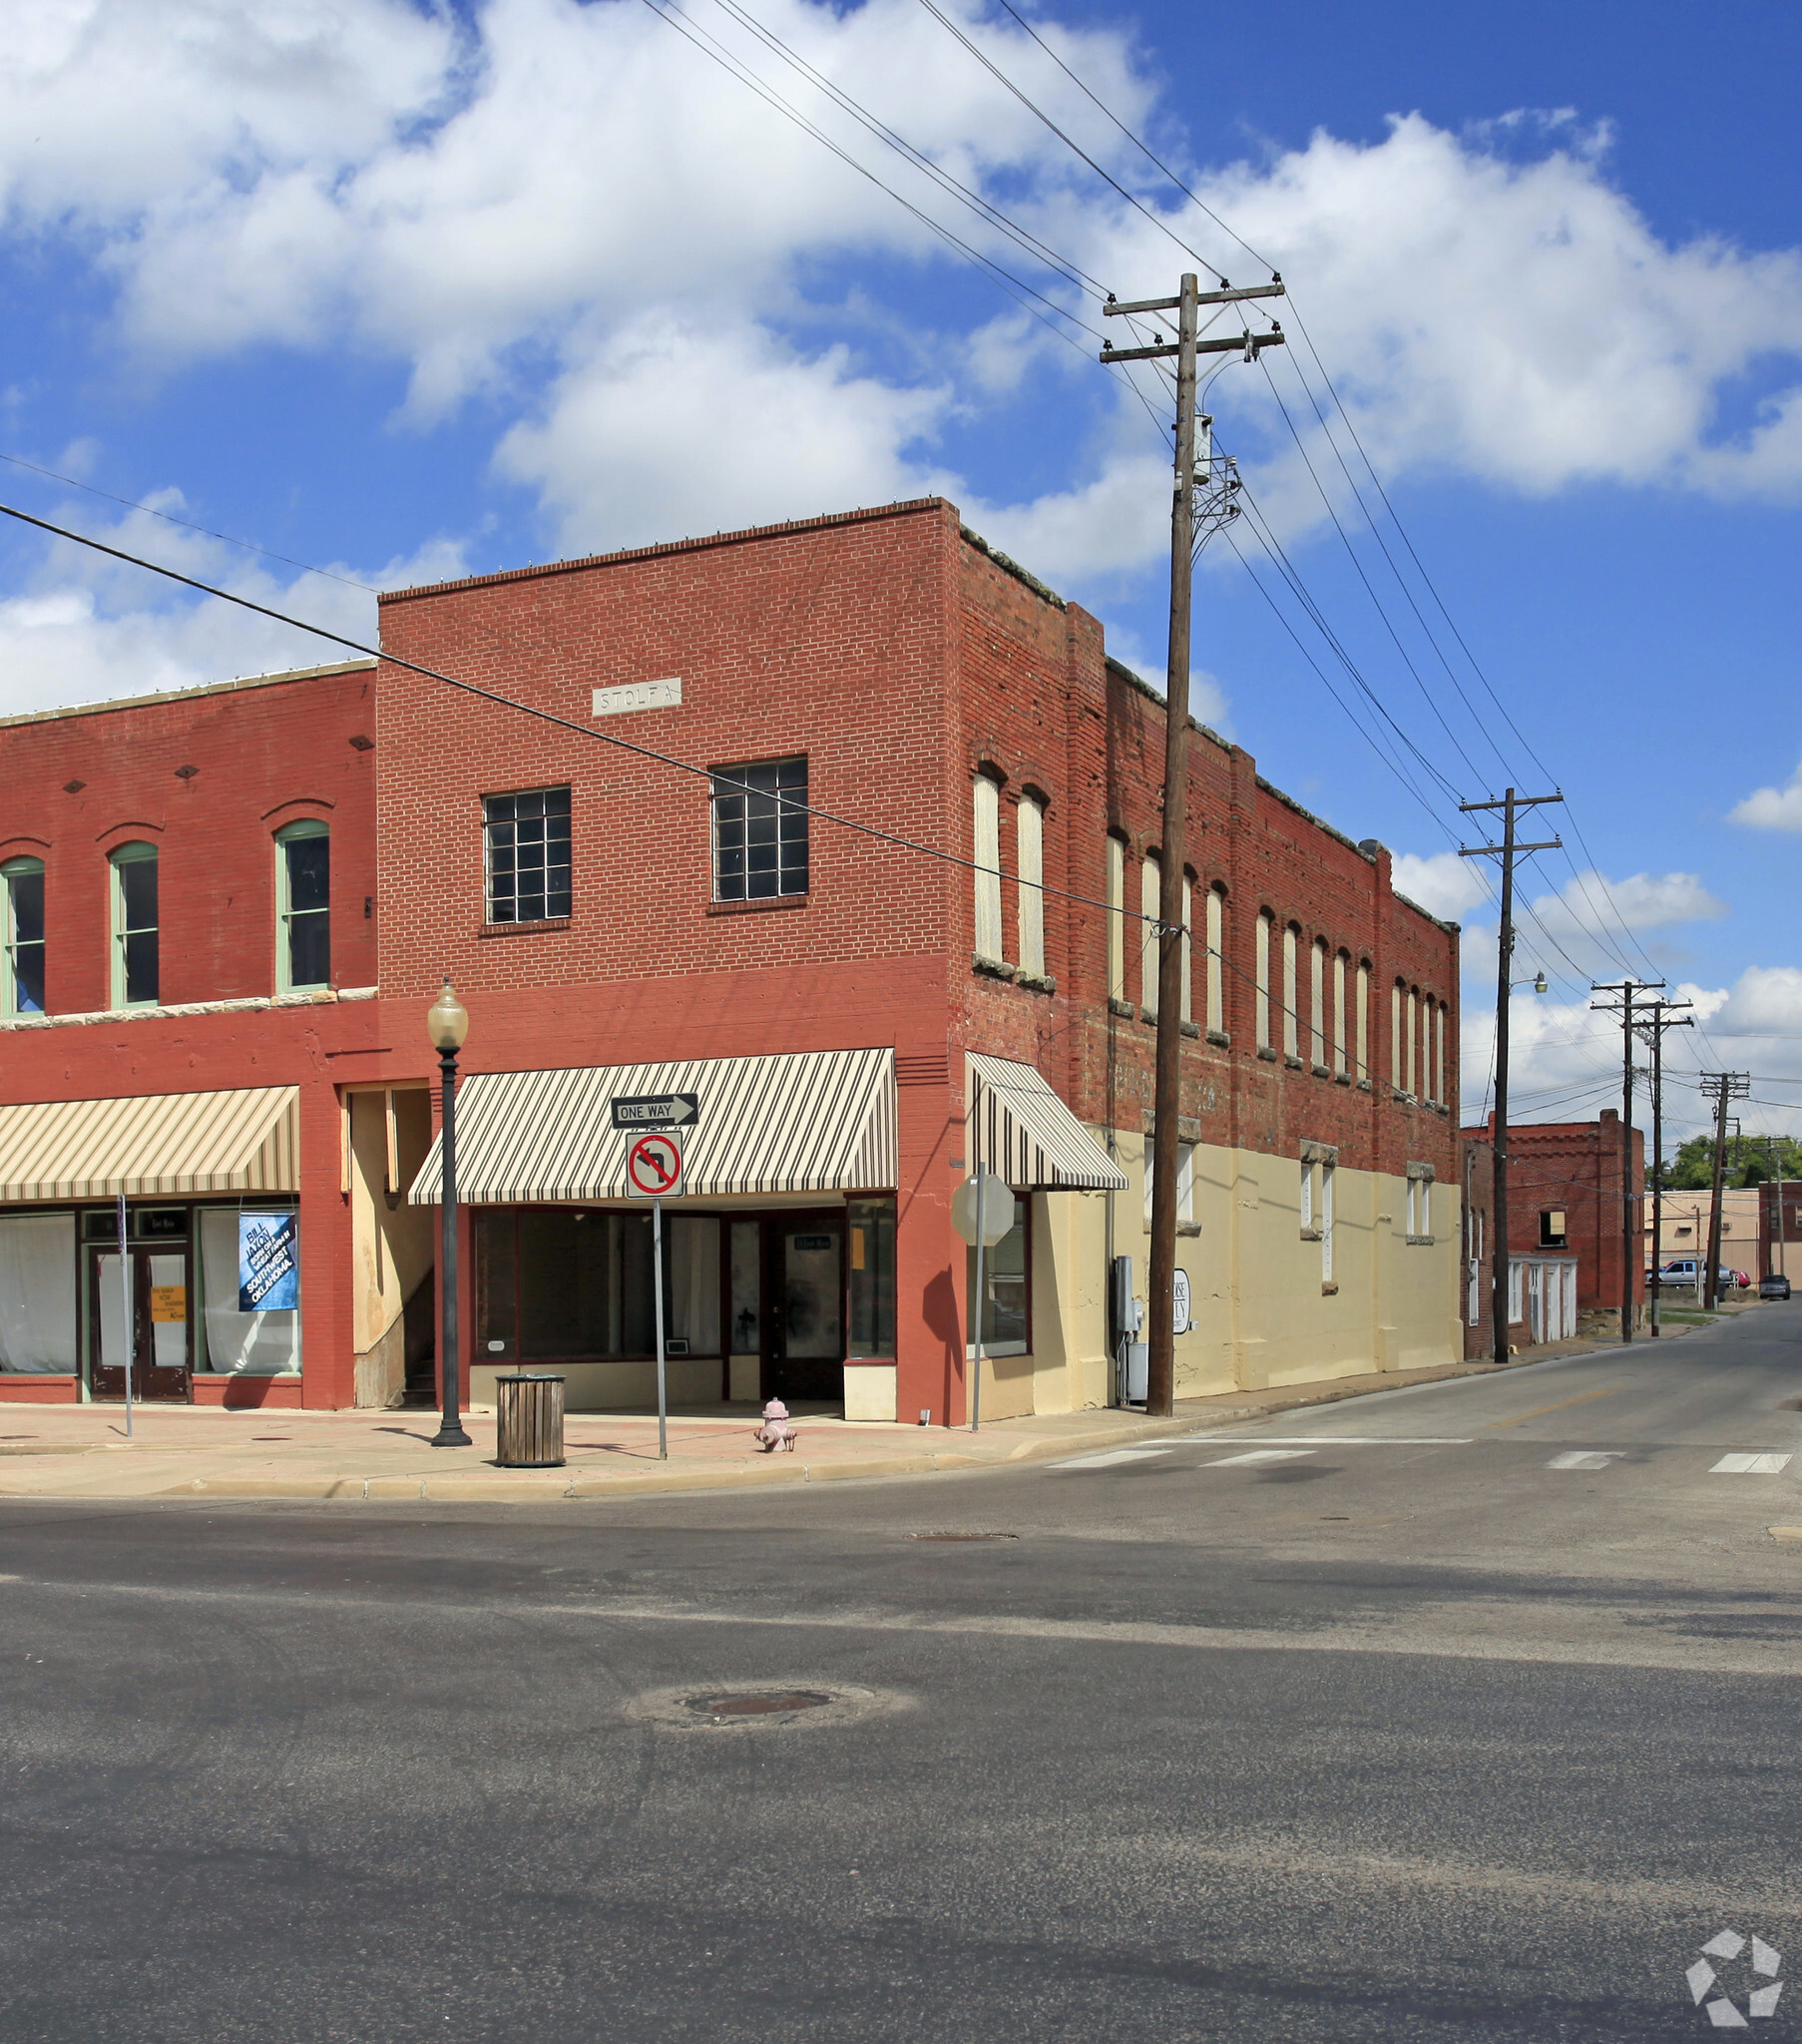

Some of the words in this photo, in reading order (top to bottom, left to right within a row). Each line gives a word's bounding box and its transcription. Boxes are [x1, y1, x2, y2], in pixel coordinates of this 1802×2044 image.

[601, 685, 673, 709] STOLFA
[621, 1106, 645, 1119] ONE
[648, 1104, 672, 1117] WAY
[246, 1223, 266, 1245] BILL
[249, 1247, 265, 1266] BORN
[253, 1251, 272, 1272] WHEAT
[245, 1245, 288, 1293] SOUTHWEST
